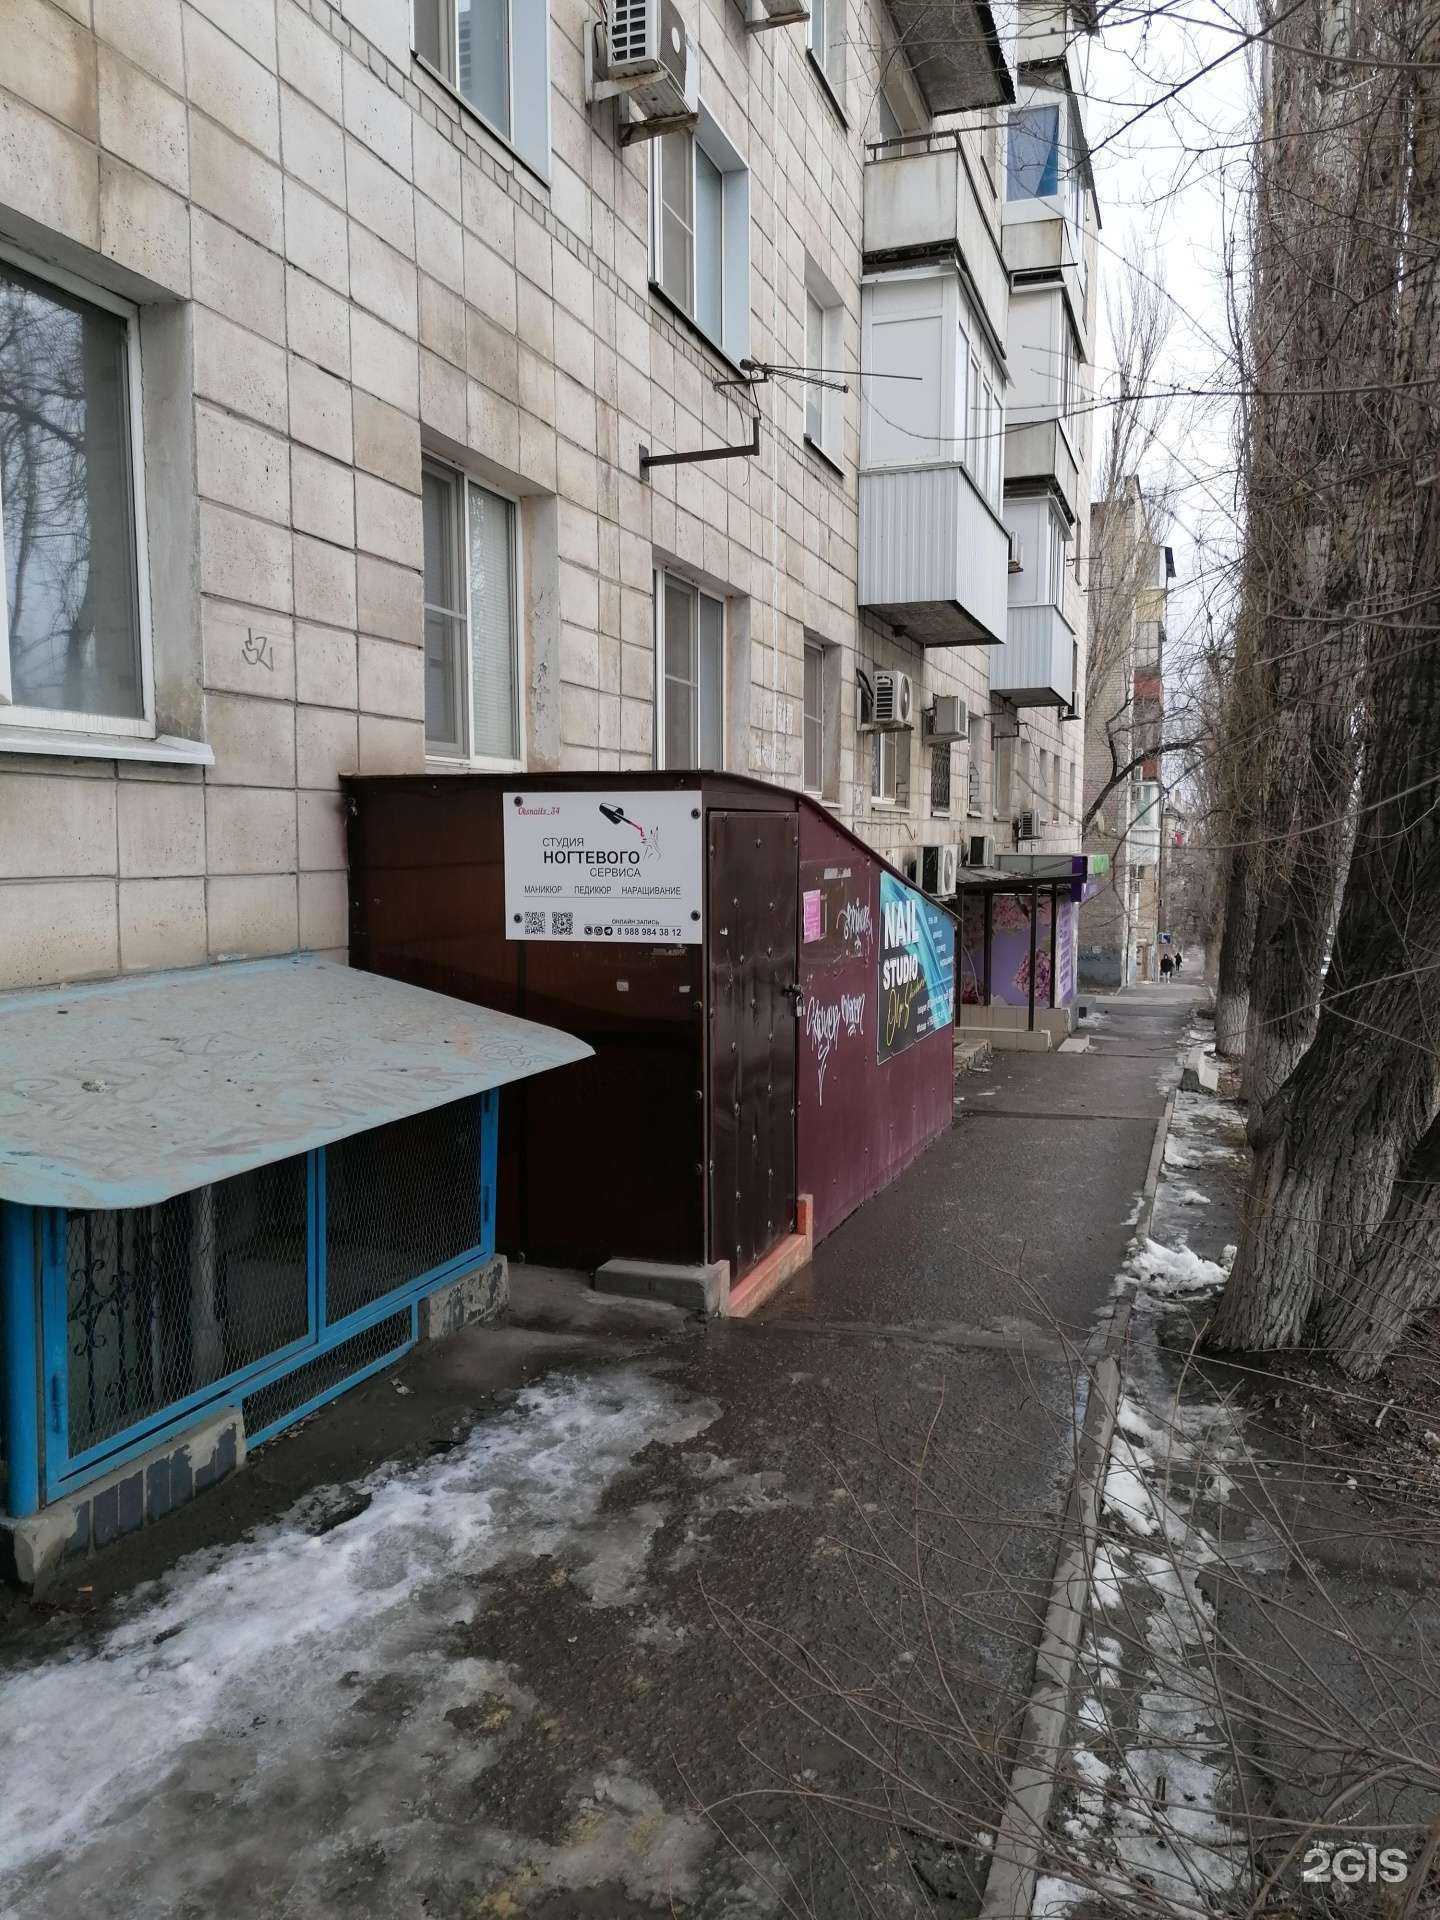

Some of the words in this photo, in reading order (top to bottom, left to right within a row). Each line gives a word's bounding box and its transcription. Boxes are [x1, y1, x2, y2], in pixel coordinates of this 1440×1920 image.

[542, 837, 584, 848] СТУДИЯ
[543, 851, 640, 864] НОГТЕВОГО
[589, 867, 641, 878] СЕРВИСА
[524, 885, 563, 894] МАНИКЮР
[574, 886, 612, 895] ПЕДИКЮР
[621, 886, 681, 896] НАРАЩИВАНИЕ
[884, 900, 920, 950] NAIL
[617, 927, 622, 936] 8
[624, 928, 640, 936] 988
[642, 928, 657, 936] 984
[659, 928, 669, 936] 38
[672, 928, 682, 937] 12
[882, 952, 918, 991] STUDIO
